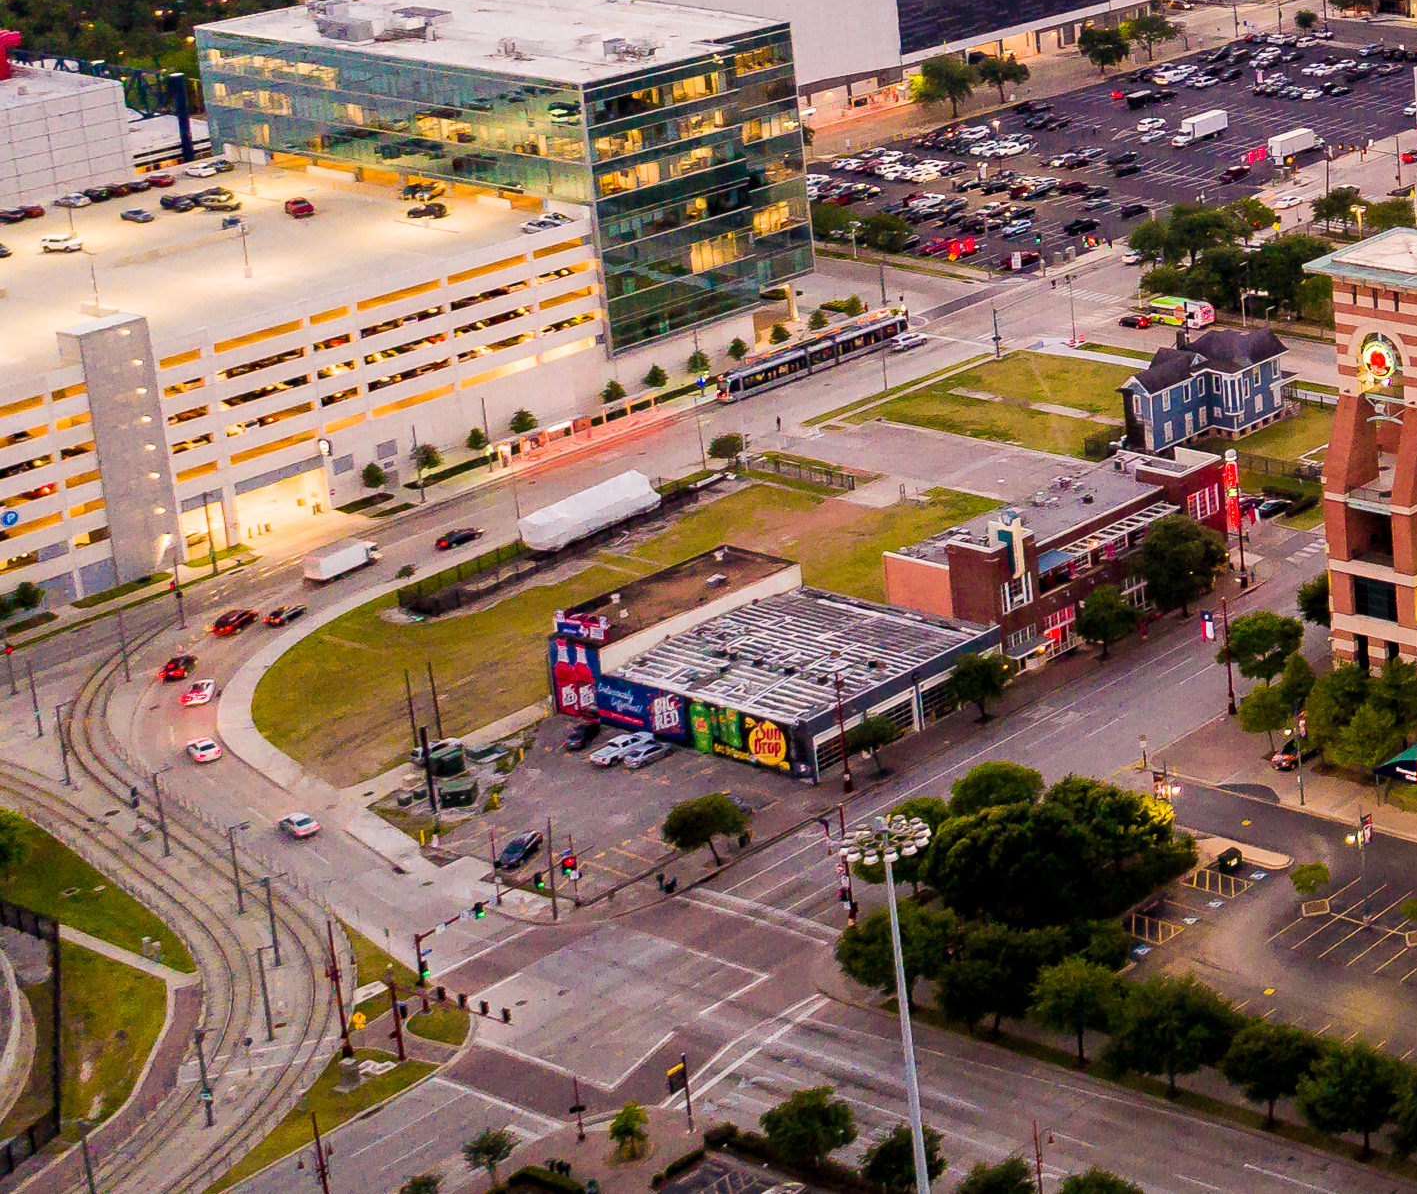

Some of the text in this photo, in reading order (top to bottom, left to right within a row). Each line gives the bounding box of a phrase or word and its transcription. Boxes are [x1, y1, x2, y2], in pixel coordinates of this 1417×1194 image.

[653, 694, 677, 714] BIG
[654, 709, 680, 731] RED
[755, 720, 782, 741] Sun
[753, 738, 782, 757] Drop
